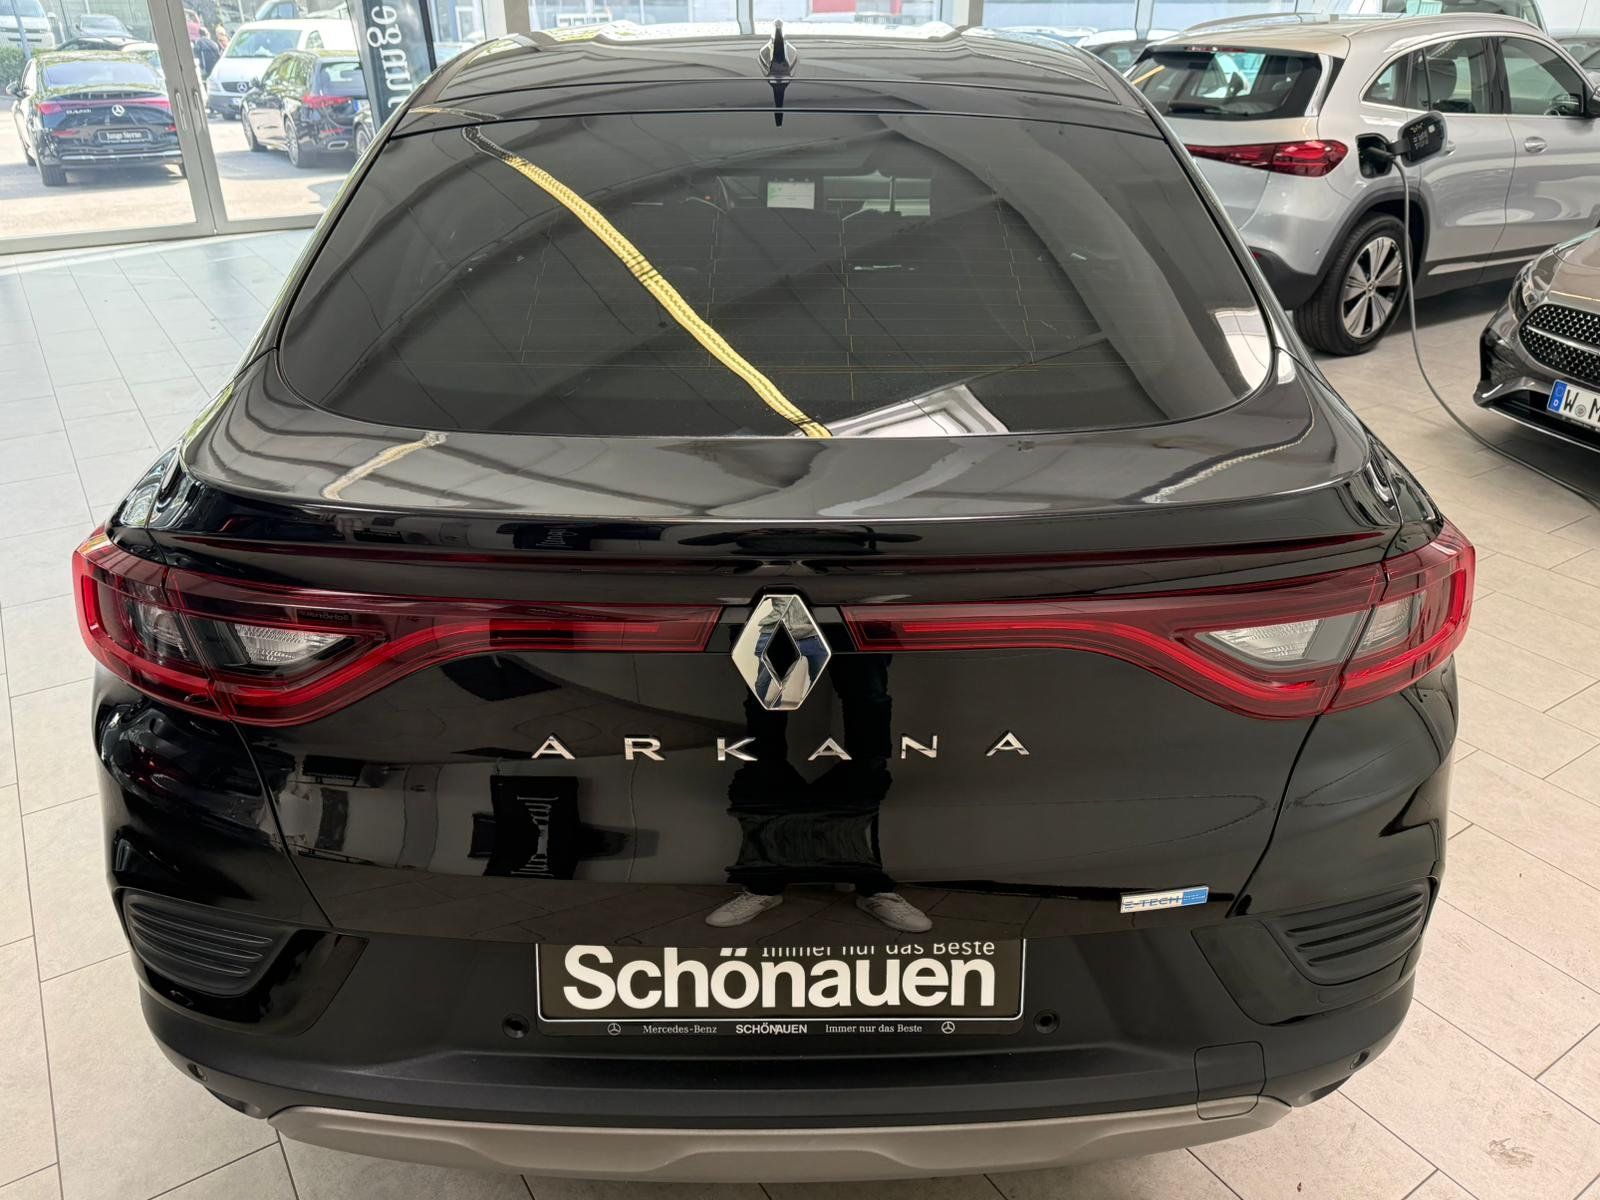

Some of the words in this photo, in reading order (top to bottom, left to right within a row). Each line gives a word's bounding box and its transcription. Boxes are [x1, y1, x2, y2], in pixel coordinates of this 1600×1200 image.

[1563, 389, 1579, 412] W
[531, 731, 1030, 762] ARKANA
[563, 944, 996, 1010] Schönauen
[642, 1024, 717, 1034] Mercedes-Benz
[735, 1021, 808, 1034] SCHÖNAUEN
[825, 1024, 856, 1033] Immer
[859, 1025, 875, 1033] nur
[878, 1024, 895, 1033] das
[897, 1024, 922, 1033] Beste
